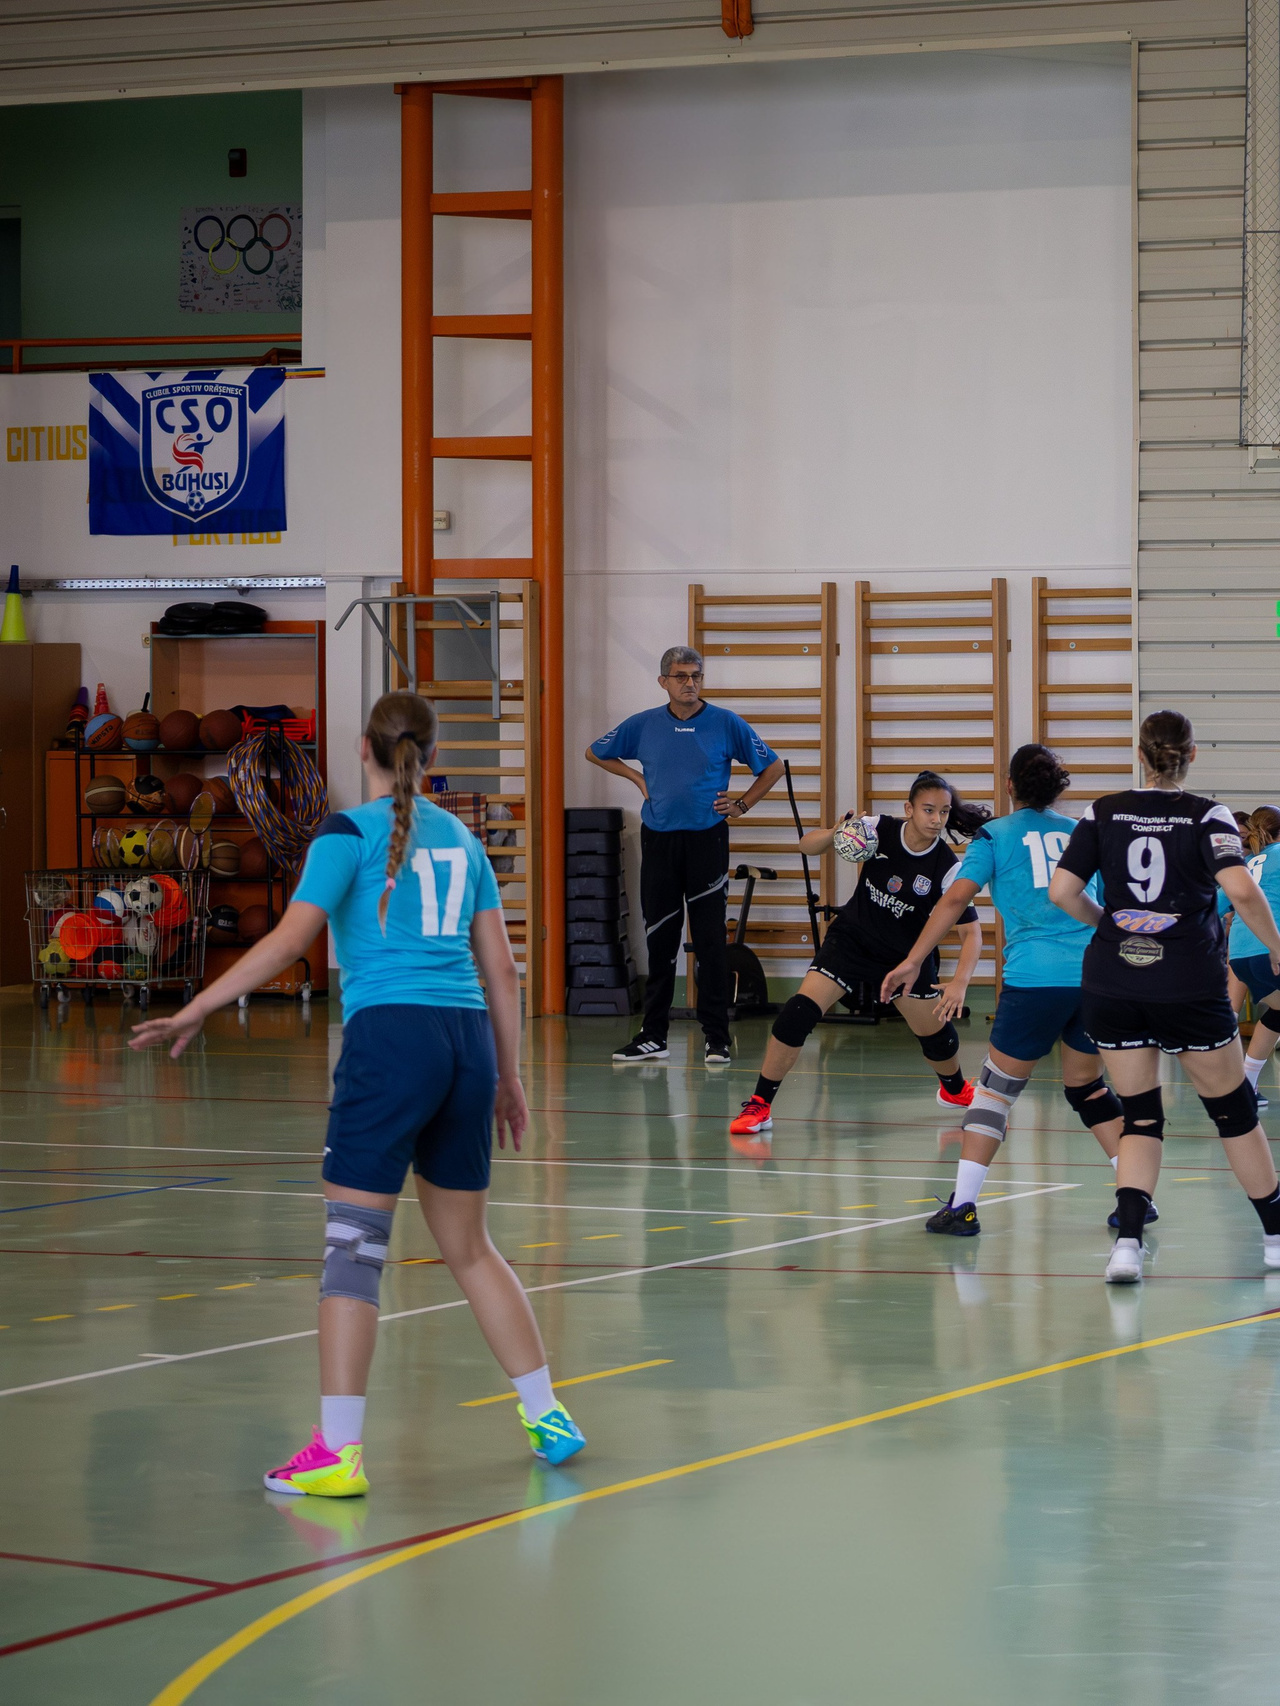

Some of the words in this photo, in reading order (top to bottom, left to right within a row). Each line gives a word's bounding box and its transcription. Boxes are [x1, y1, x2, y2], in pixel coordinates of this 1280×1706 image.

[146, 388, 171, 399] CLUBUL
[172, 385, 202, 394] SPORTIV
[155, 396, 233, 434] CSO
[7, 425, 87, 462] CITIUS
[1112, 814, 1167, 824] INTERNATIONAL
[1131, 824, 1174, 832] CONSTRCT
[1127, 836, 1165, 903] 9
[410, 847, 469, 936] 17
